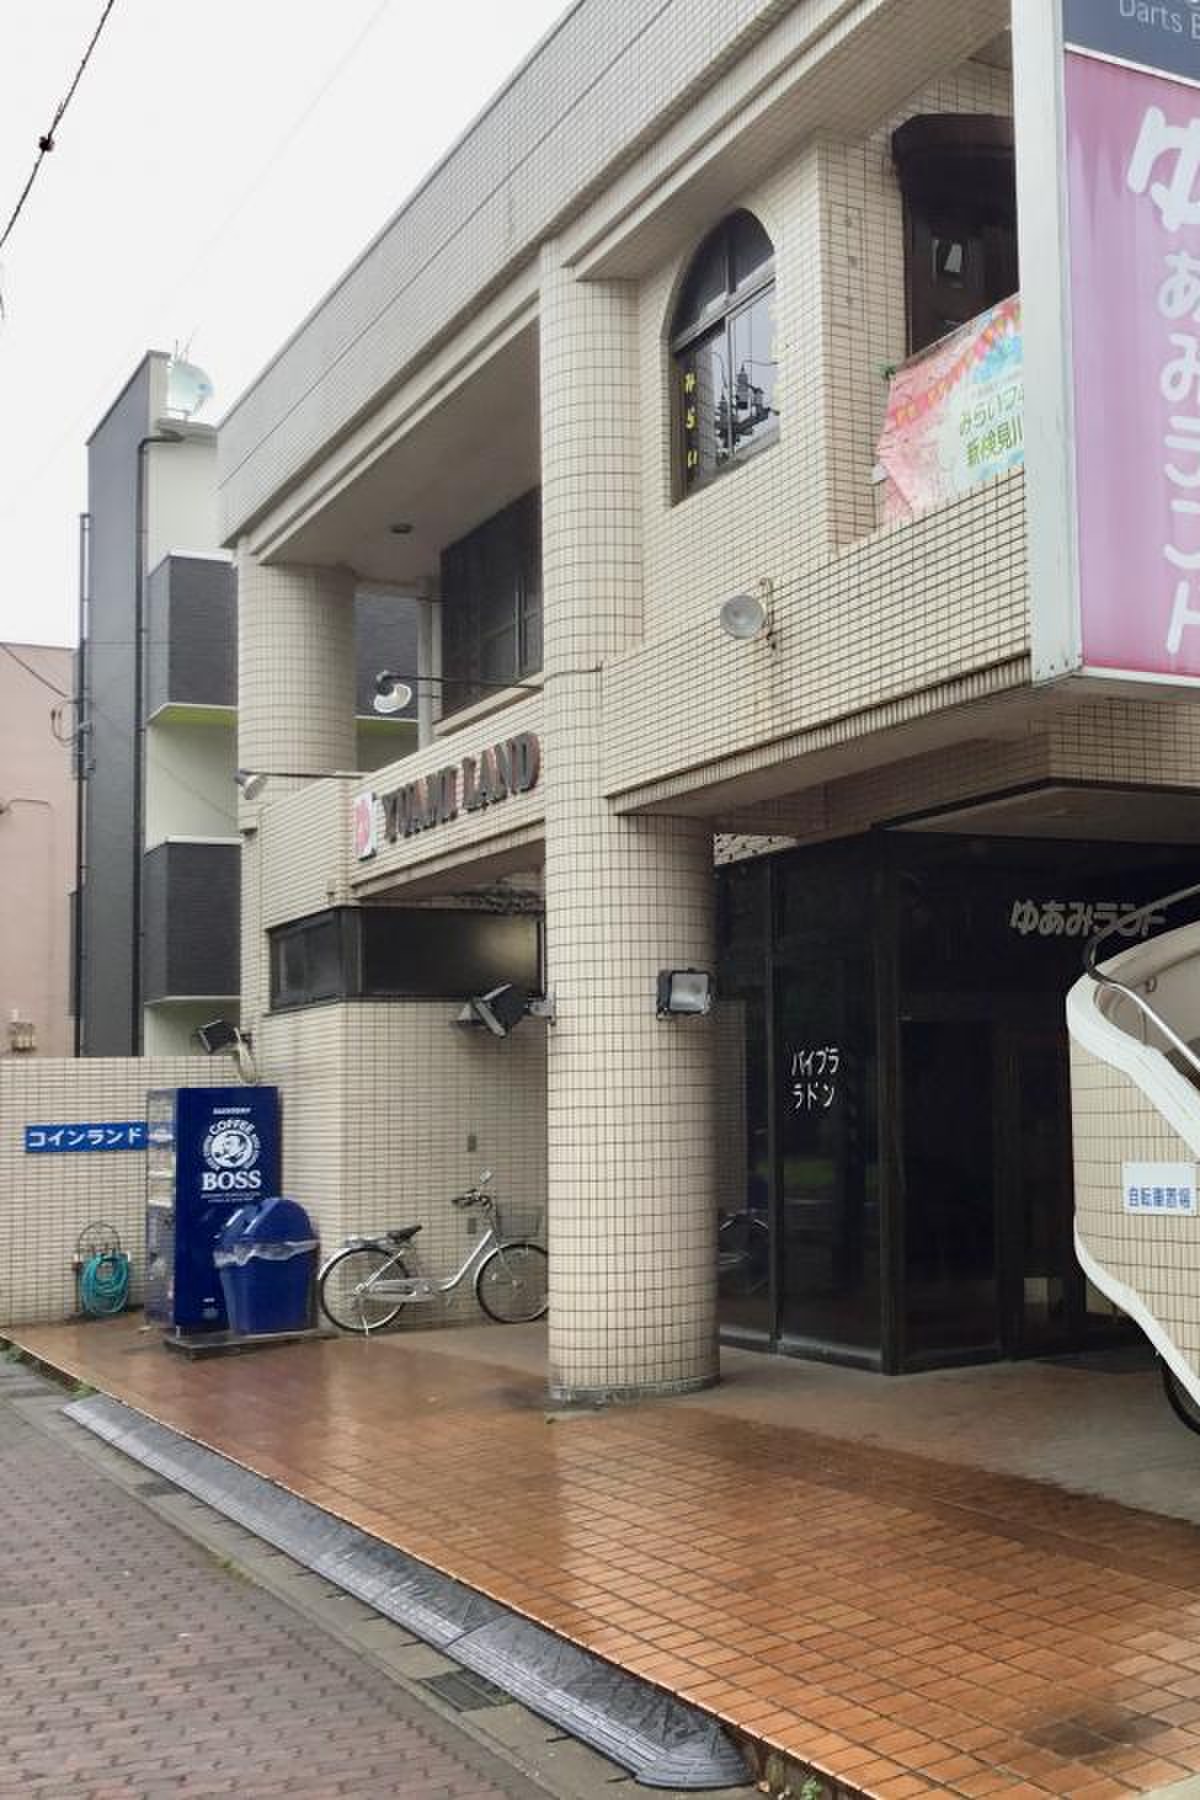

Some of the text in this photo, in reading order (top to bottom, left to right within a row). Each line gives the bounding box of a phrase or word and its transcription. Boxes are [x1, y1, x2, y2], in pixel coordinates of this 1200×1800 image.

[1120, 0, 1183, 33] Darts
[960, 384, 1024, 436] みらいフ
[791, 1046, 840, 1077] バイブラ
[792, 1082, 835, 1111] ラドン
[208, 1119, 256, 1136] COFFEE
[201, 1169, 262, 1192] BOSS
